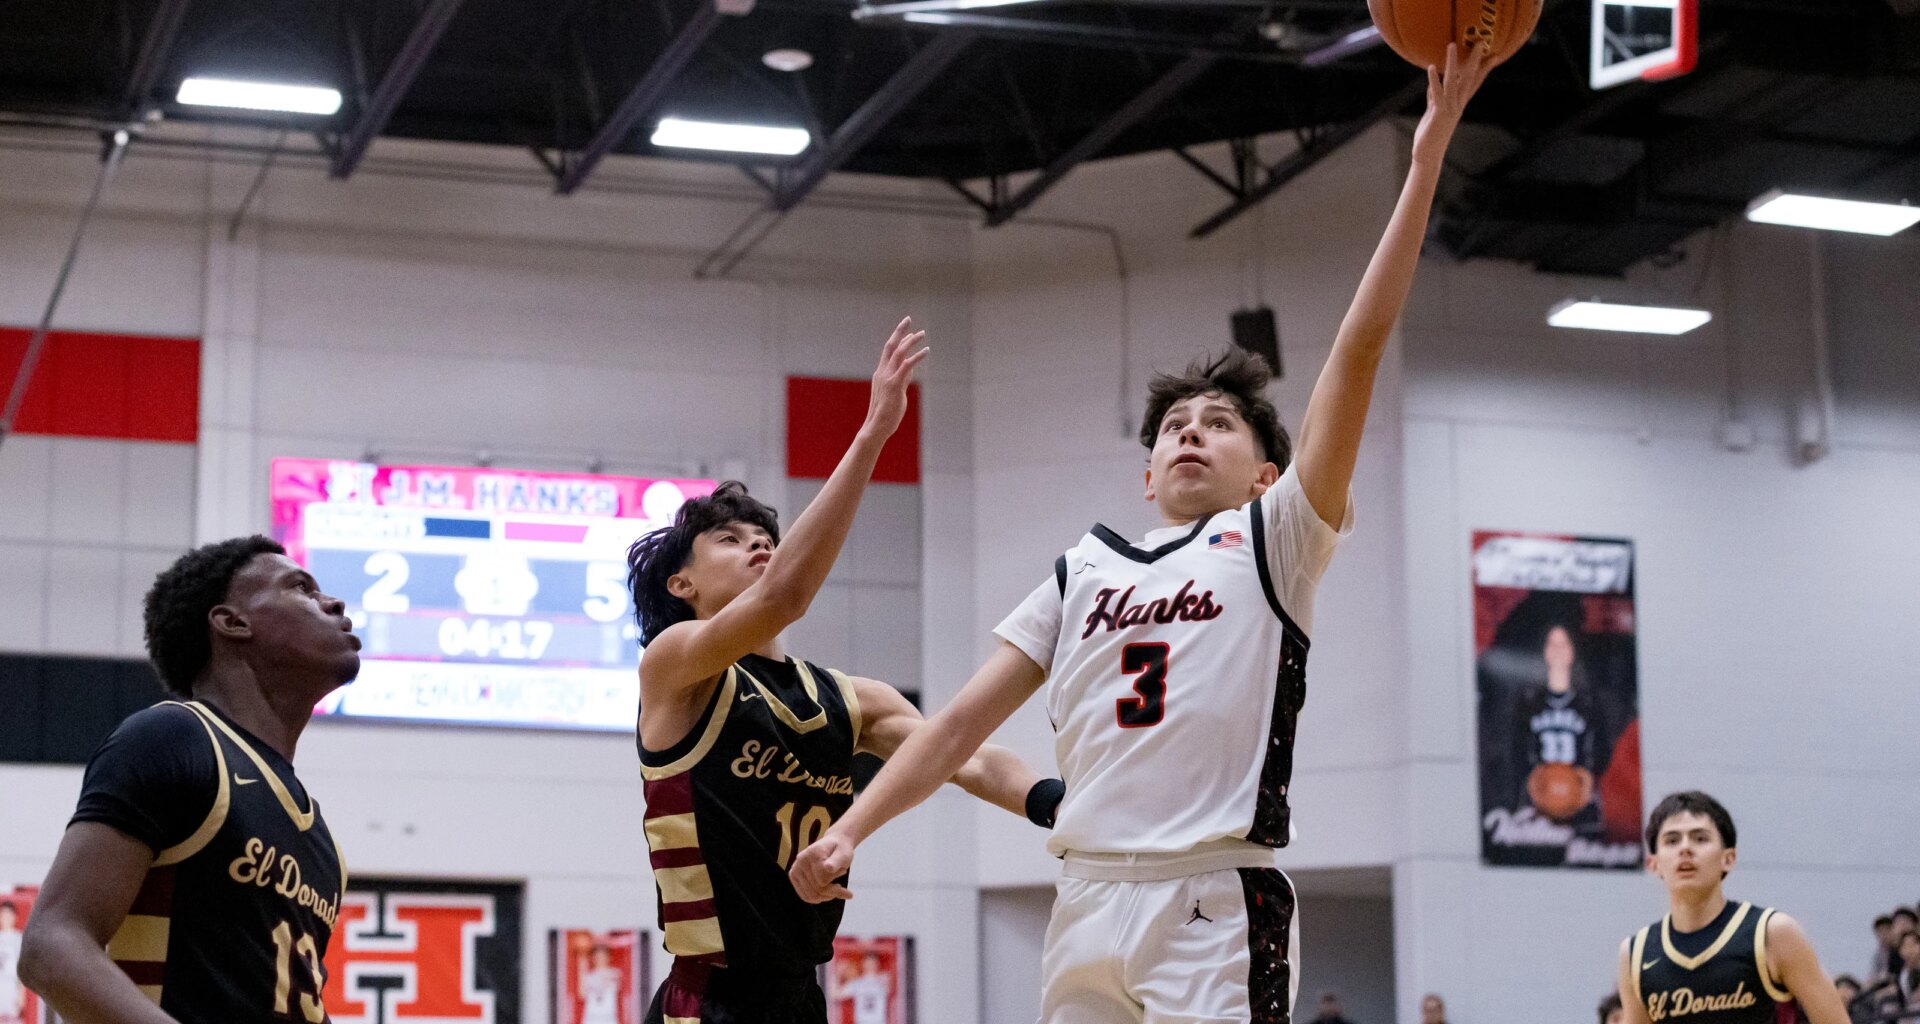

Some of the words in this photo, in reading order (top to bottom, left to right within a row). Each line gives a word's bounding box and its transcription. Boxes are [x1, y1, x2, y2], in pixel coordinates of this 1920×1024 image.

[383, 468, 468, 510] J.M.
[476, 472, 620, 516] HANKS
[362, 552, 411, 613] 2
[583, 562, 630, 622] 5
[1081, 579, 1223, 640] Hanks
[437, 617, 553, 660] 04:17
[1116, 641, 1170, 728] 3
[730, 739, 779, 779] El
[228, 837, 276, 887] El
[776, 802, 831, 871] 10
[272, 920, 325, 1024] 13
[1647, 991, 1669, 1022] El
[1669, 981, 1757, 1017] Dorado
